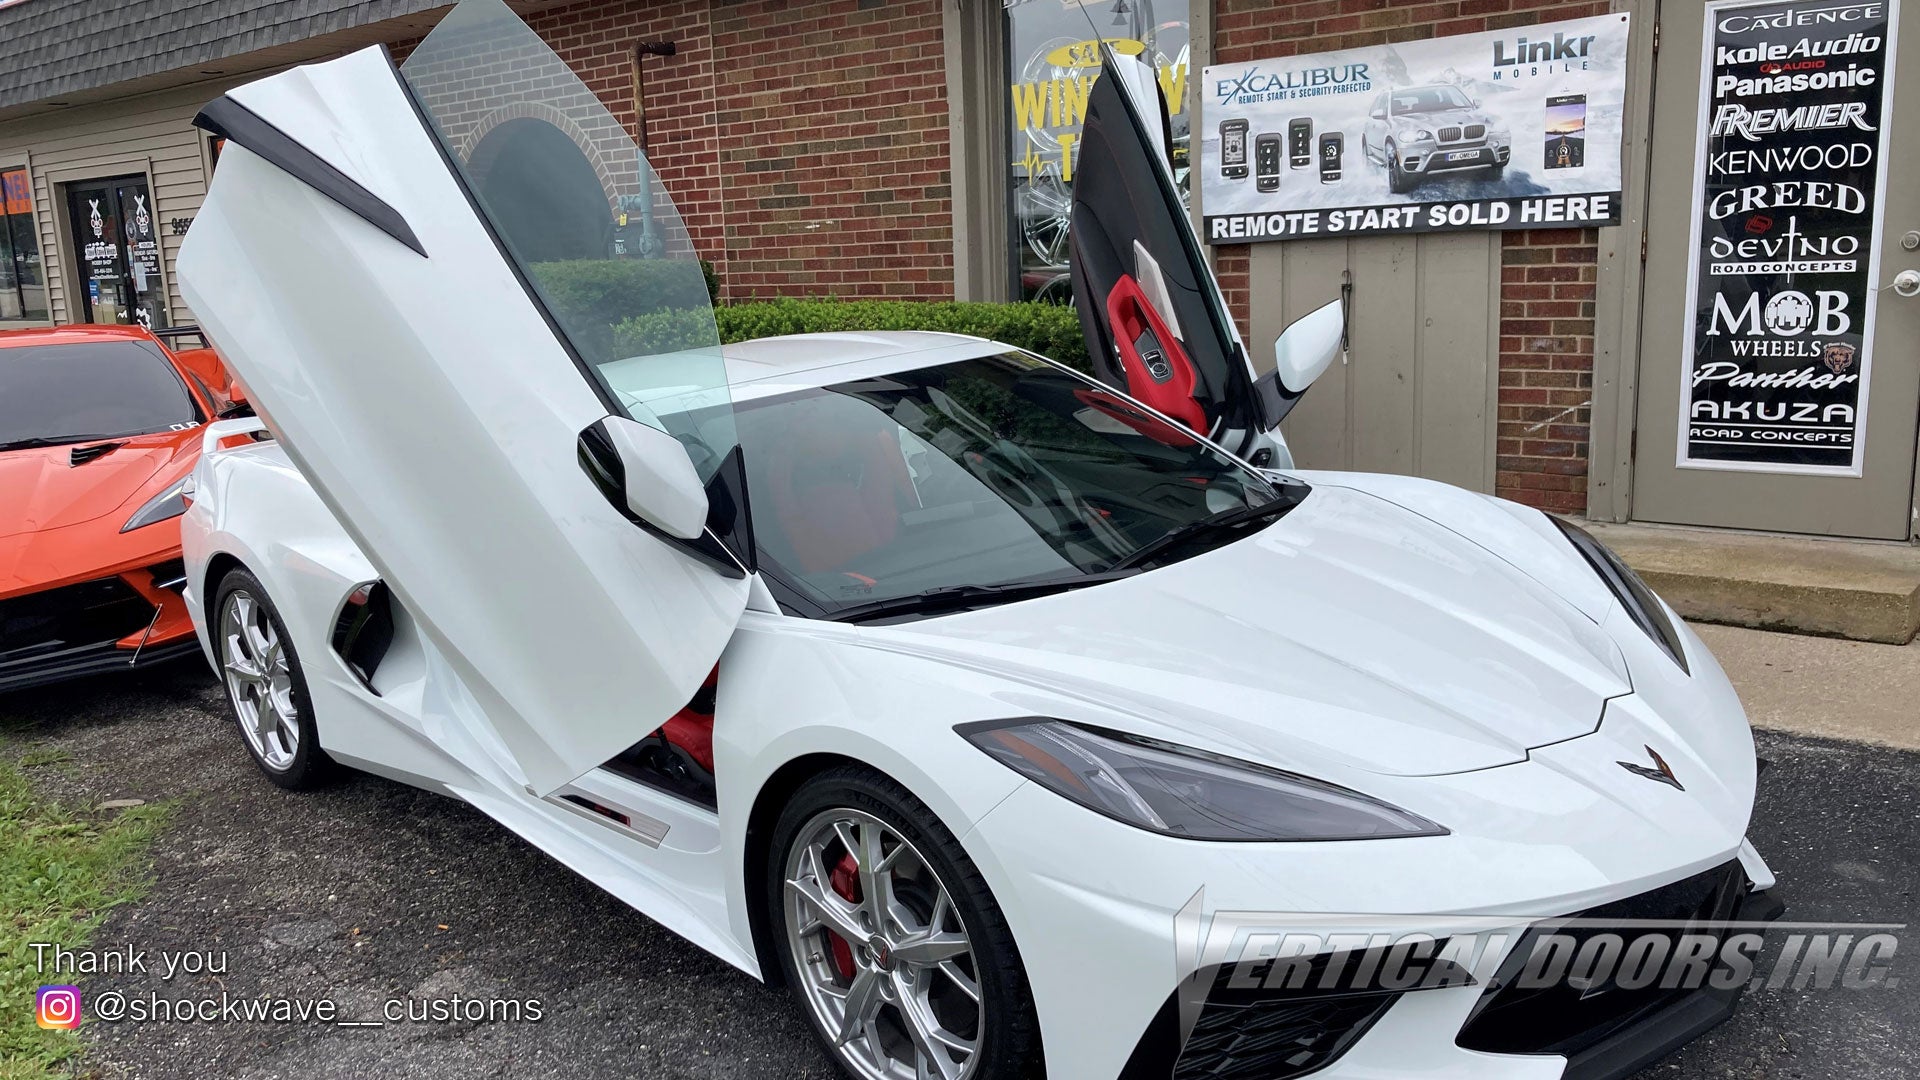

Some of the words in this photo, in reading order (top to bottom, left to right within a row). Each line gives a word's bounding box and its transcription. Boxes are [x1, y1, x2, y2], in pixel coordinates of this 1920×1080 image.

[1493, 32, 1595, 67] Linkr
[1216, 64, 1371, 105] EXCALIBUR
[1493, 61, 1588, 80] MOBILE
[1716, 63, 1876, 98] Panasonic
[1238, 93, 1264, 105] REMOTE
[1267, 90, 1287, 102] START
[1290, 89, 1296, 99] &
[1299, 86, 1332, 98] SECURITY
[1333, 81, 1371, 94] PERFECTED
[1709, 101, 1877, 141] PREMIER
[1709, 143, 1872, 175] KENWOOD
[1709, 181, 1866, 220] GREED
[1212, 212, 1319, 239] REMOTE
[1327, 206, 1420, 232] START
[1428, 201, 1510, 227] SOLD
[1520, 195, 1610, 223] HERE
[1712, 263, 1757, 274] ROAD
[1761, 260, 1853, 272] CONCEPTS
[1706, 290, 1850, 337] MOB
[1730, 340, 1821, 357] WHEELS
[1693, 362, 1858, 390] Panther
[1691, 400, 1853, 423] AKUZA
[1690, 428, 1743, 438] ROAD
[1750, 430, 1852, 442] CONCEPTS
